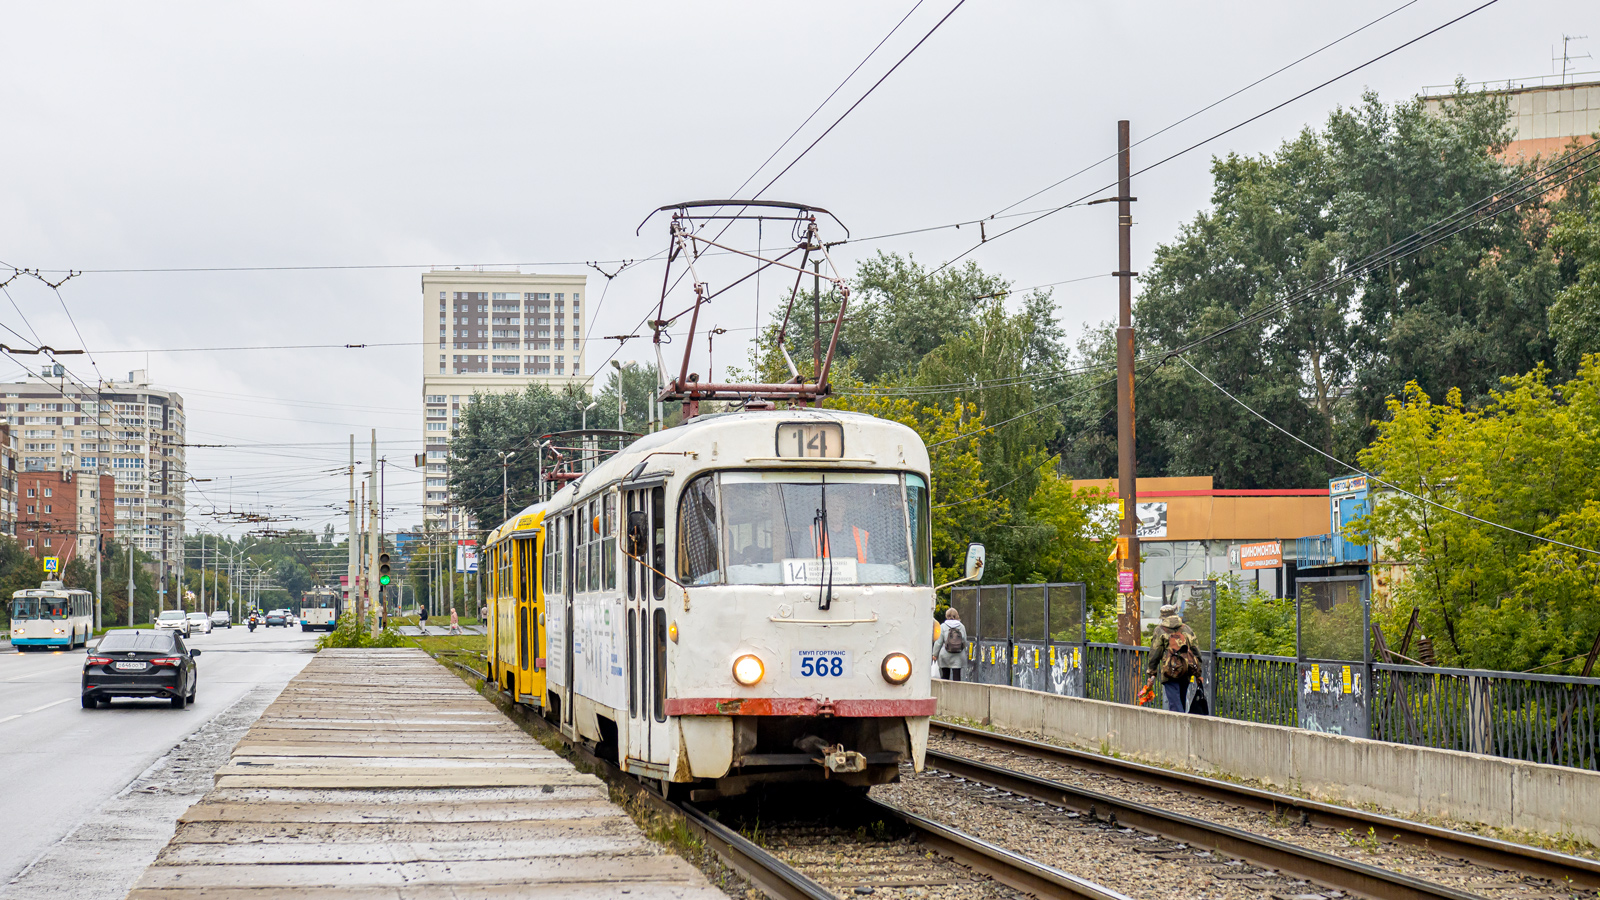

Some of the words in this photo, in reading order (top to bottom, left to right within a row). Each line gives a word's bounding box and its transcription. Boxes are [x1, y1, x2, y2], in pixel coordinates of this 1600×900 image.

[793, 429, 828, 458] 14
[1241, 544, 1281, 558] ШИНОМОНТАЖ
[788, 562, 808, 582] 14
[800, 656, 844, 677] 568
